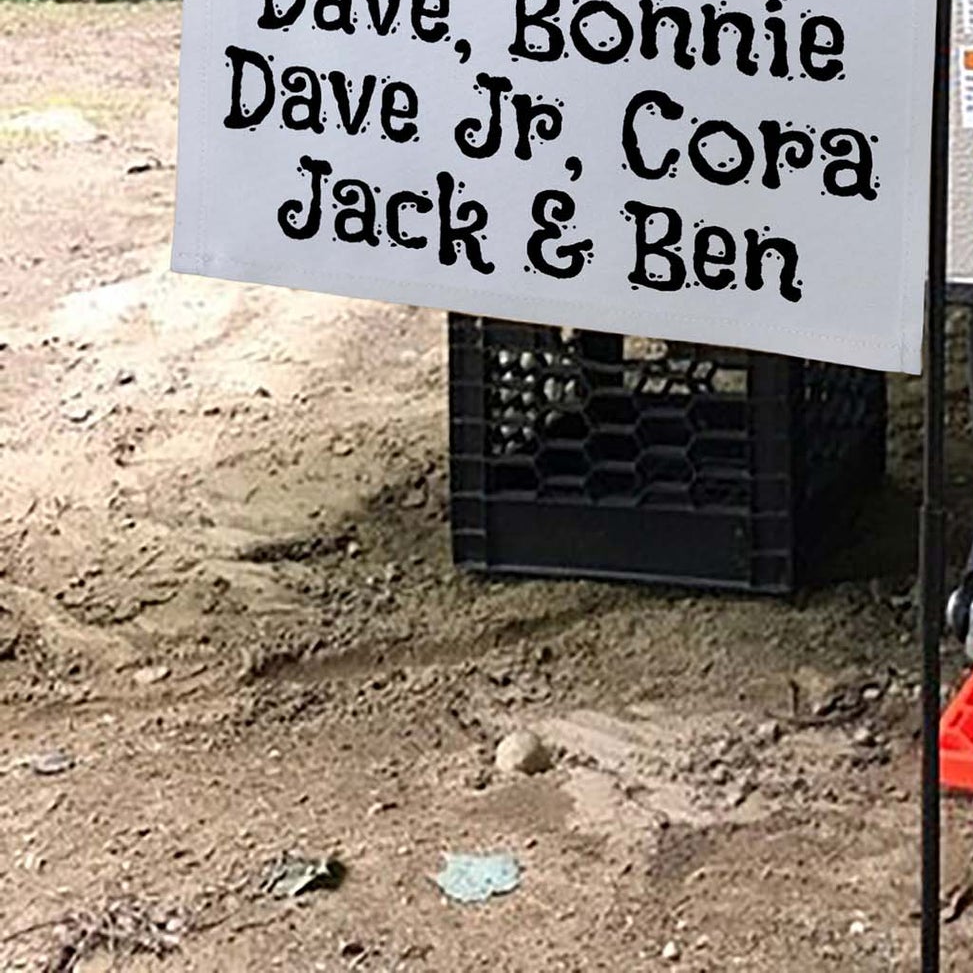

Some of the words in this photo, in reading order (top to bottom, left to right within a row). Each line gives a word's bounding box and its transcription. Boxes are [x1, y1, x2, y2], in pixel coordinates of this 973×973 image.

[223, 45, 420, 144] Dave
[454, 72, 583, 182] Jr,
[621, 89, 880, 202] Cora
[277, 154, 496, 275] Jack
[525, 189, 594, 280] &
[620, 200, 803, 304] Ben
